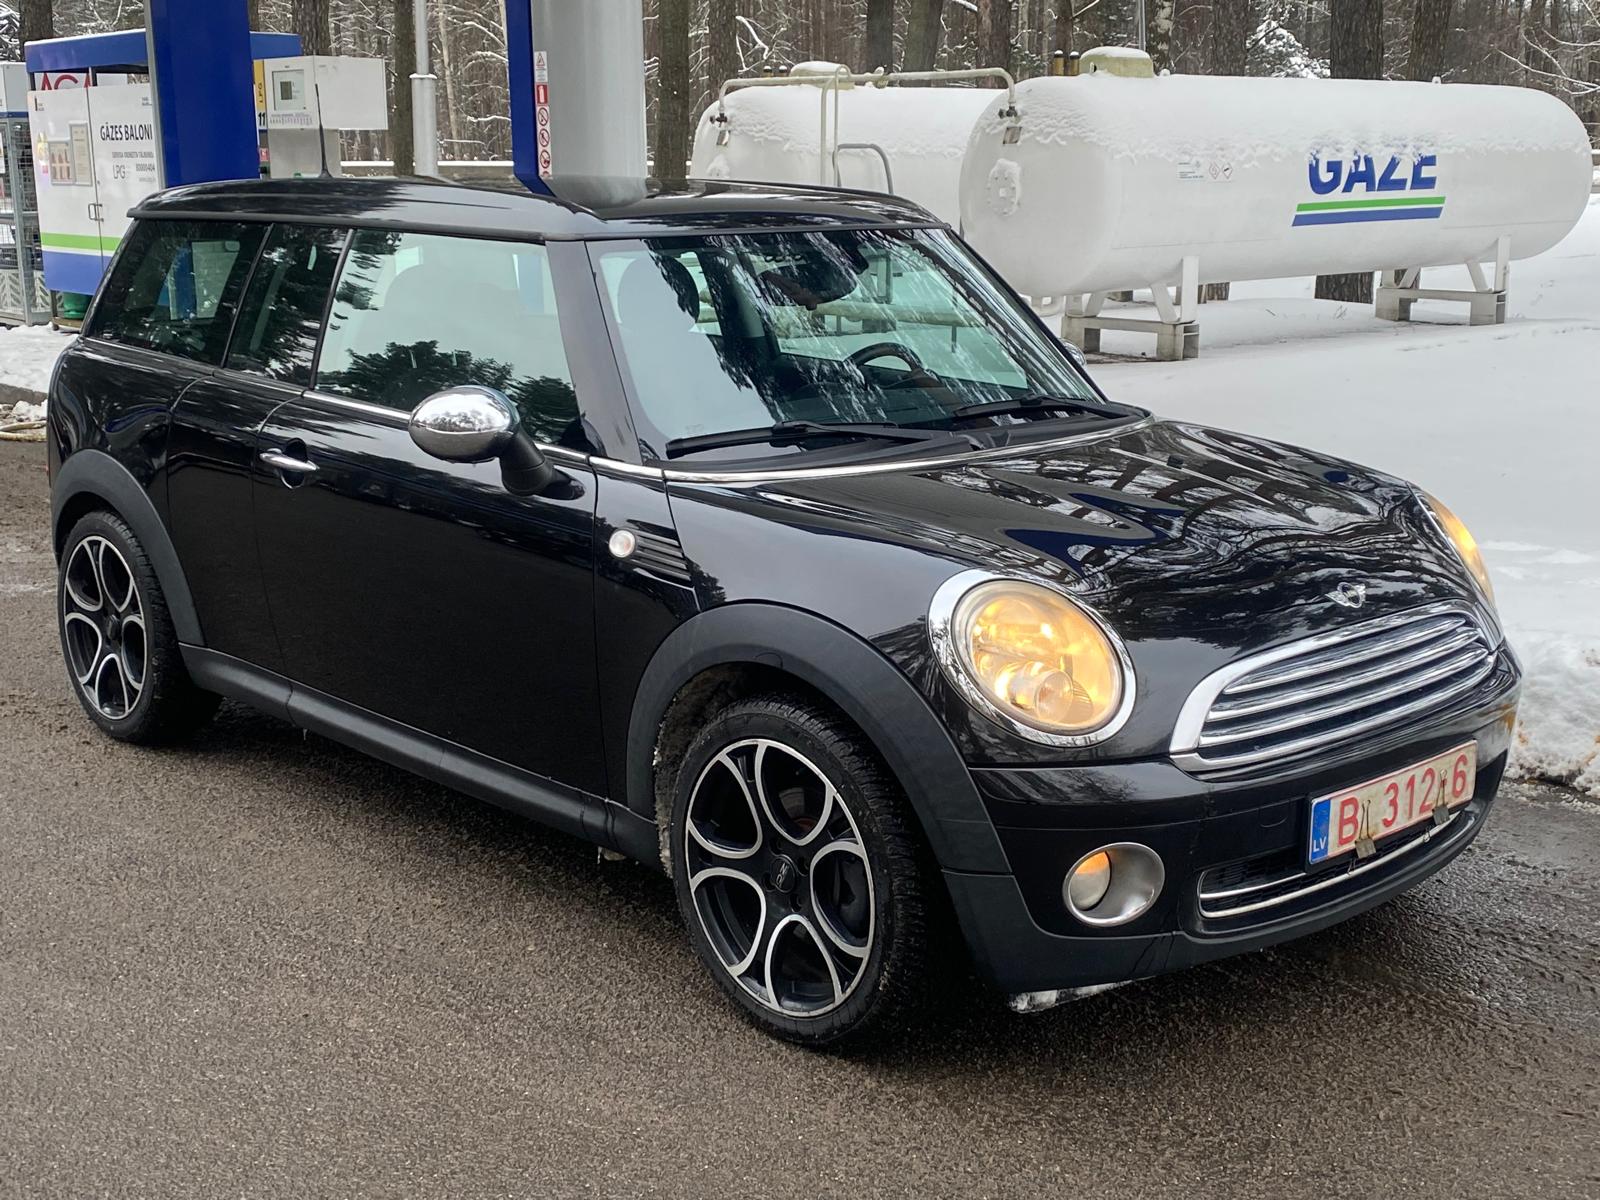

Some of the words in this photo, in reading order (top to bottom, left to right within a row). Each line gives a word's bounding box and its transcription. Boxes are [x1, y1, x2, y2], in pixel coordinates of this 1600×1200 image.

[258, 112, 266, 127] 11
[100, 121, 123, 141] GĀZES
[124, 122, 153, 141] BALONI
[1338, 797, 1359, 847] B
[1312, 835, 1328, 852] LV
